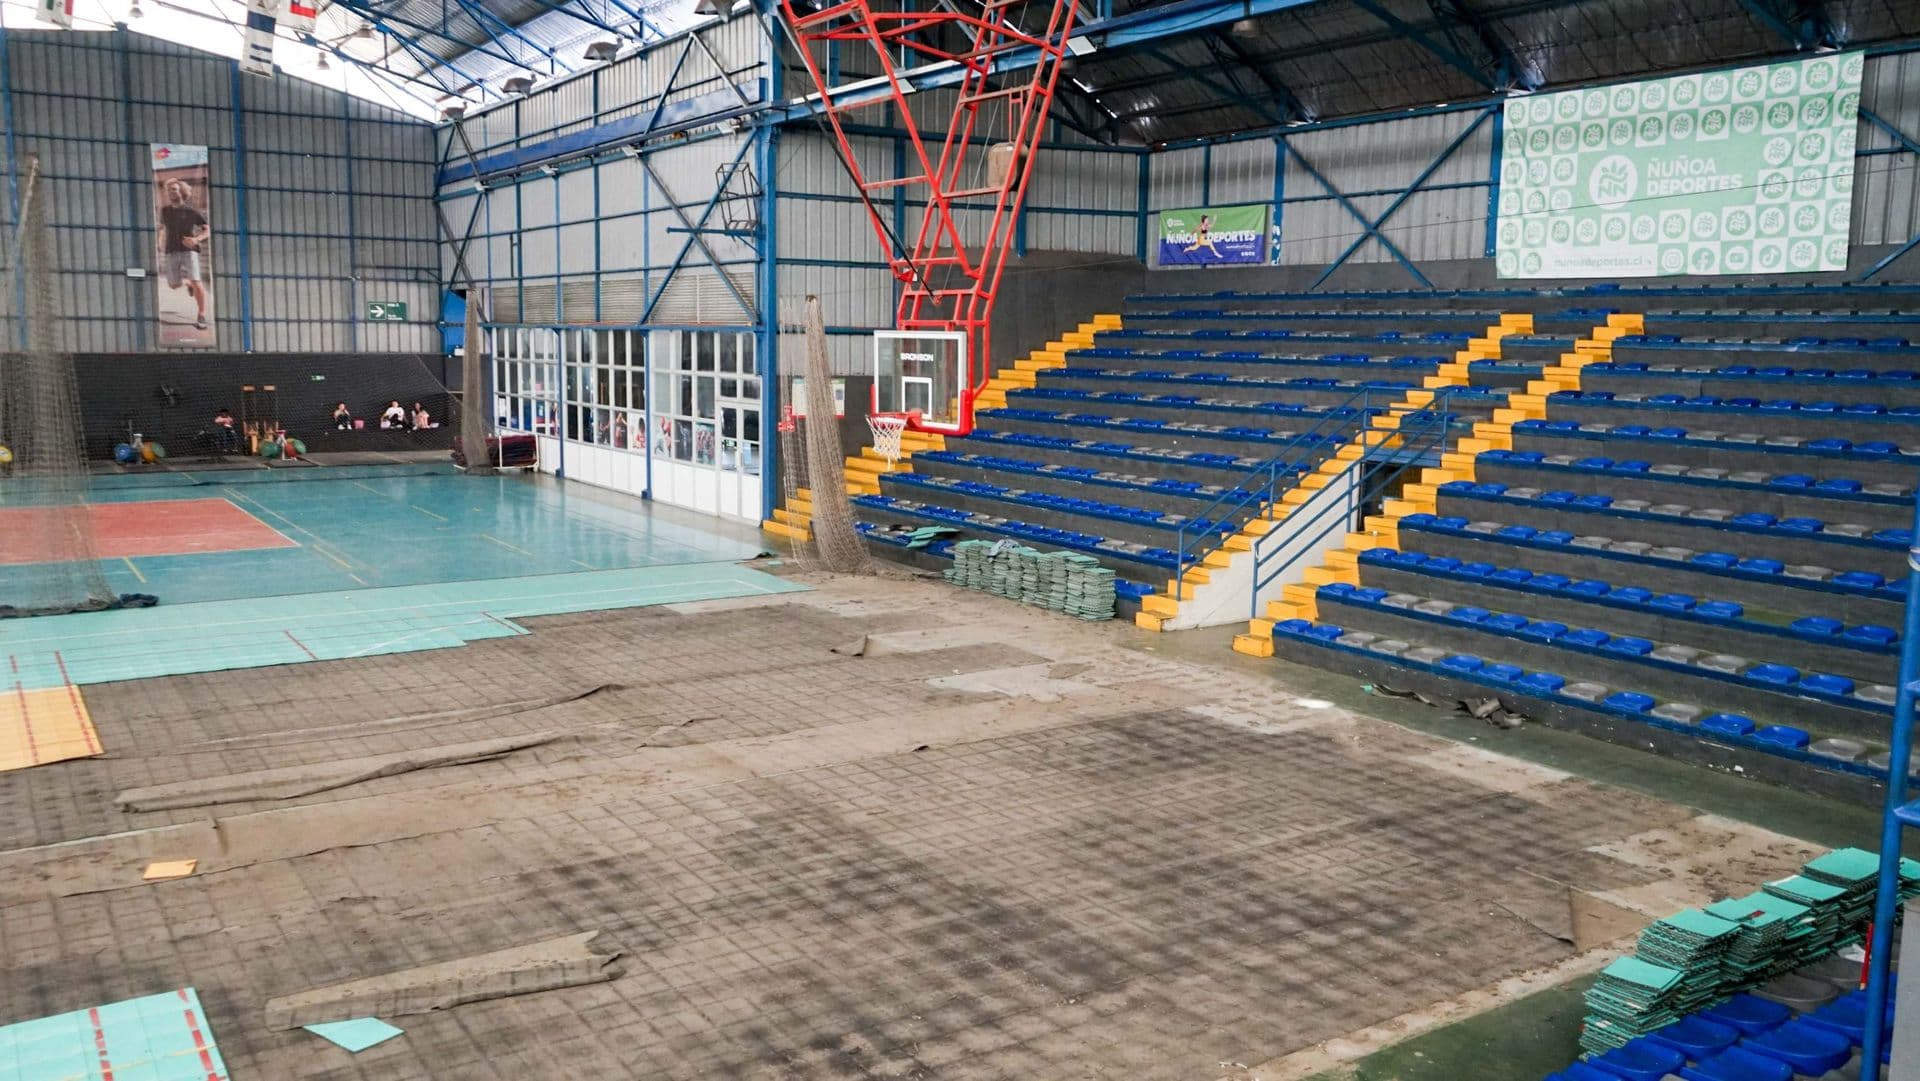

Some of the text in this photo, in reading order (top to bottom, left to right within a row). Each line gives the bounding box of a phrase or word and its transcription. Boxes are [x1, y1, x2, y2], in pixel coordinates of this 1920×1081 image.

[1647, 155, 1716, 177] ÑUÑOA
[1646, 173, 1743, 196] DEPORTES
[1166, 230, 1255, 244] ÑUÑOA DEPORTES
